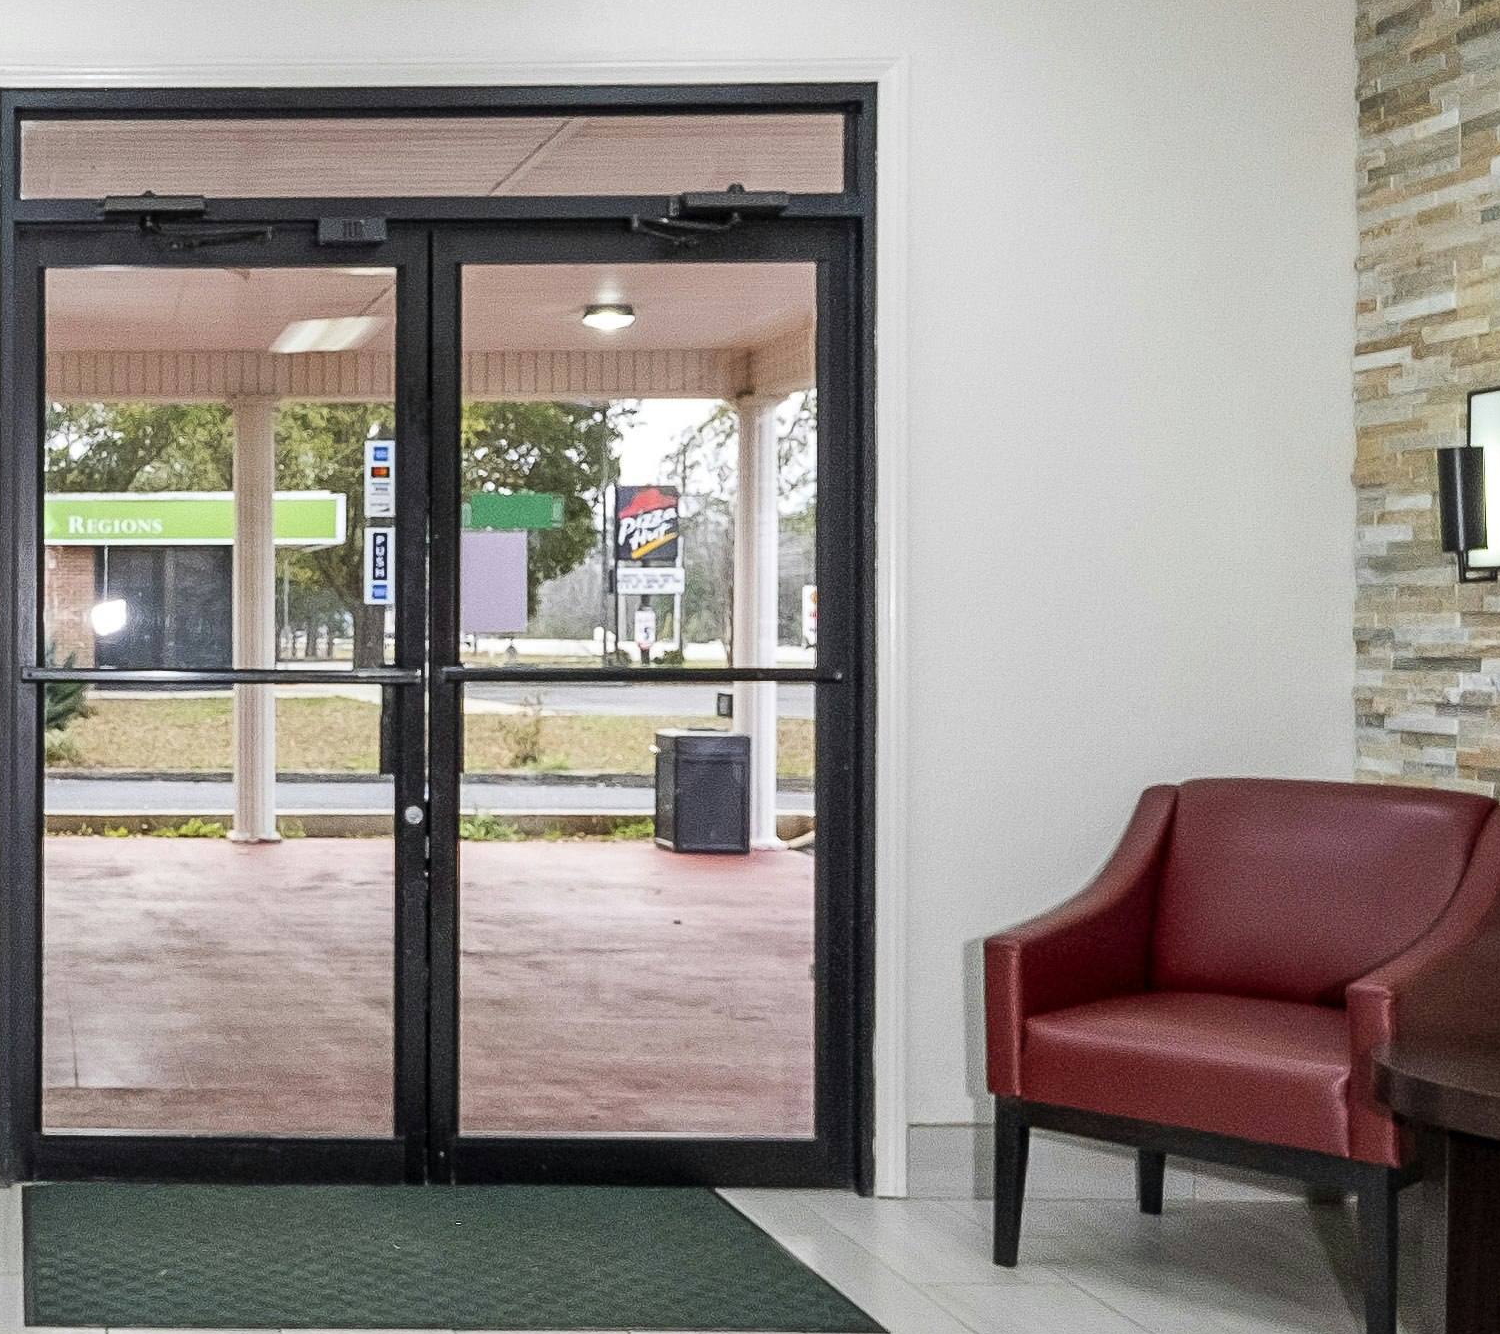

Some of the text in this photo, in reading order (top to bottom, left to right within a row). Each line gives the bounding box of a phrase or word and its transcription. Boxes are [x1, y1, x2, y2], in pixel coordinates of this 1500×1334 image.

[67, 514, 163, 535] REGIONS
[618, 507, 678, 547] Pizza
[629, 522, 671, 551] Hut
[374, 534, 386, 579] PUSH
